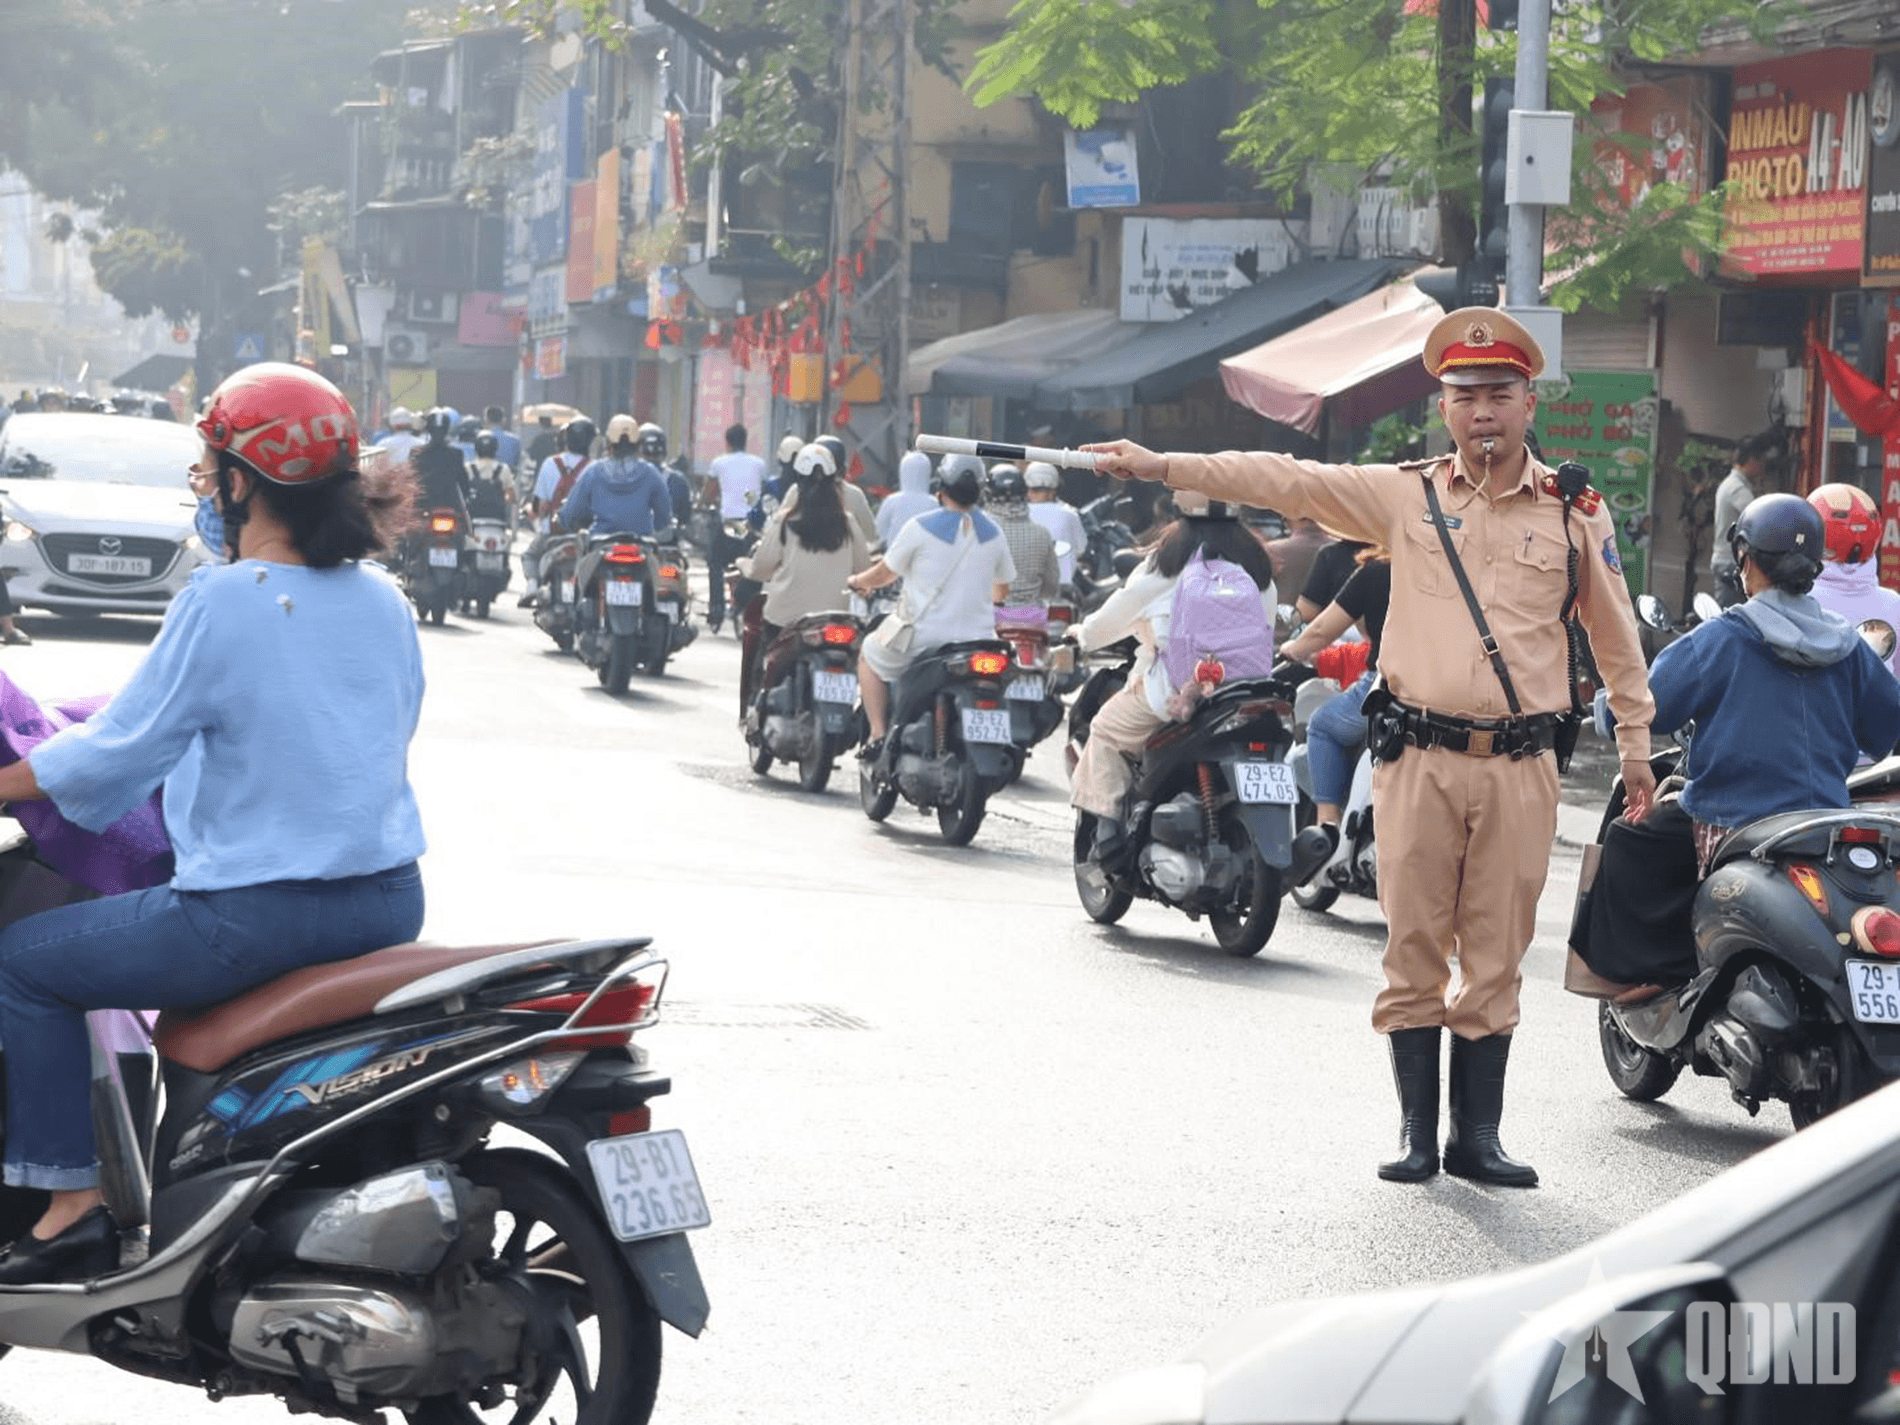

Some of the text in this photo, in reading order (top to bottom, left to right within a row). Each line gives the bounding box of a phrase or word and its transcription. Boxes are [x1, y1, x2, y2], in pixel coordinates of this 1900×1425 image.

[1727, 154, 1802, 200] PHOTO
[1243, 783, 1294, 800] 474.05
[282, 1045, 434, 1104] VISION
[606, 1137, 681, 1185] 29-B1
[612, 1180, 705, 1233] 236.65
